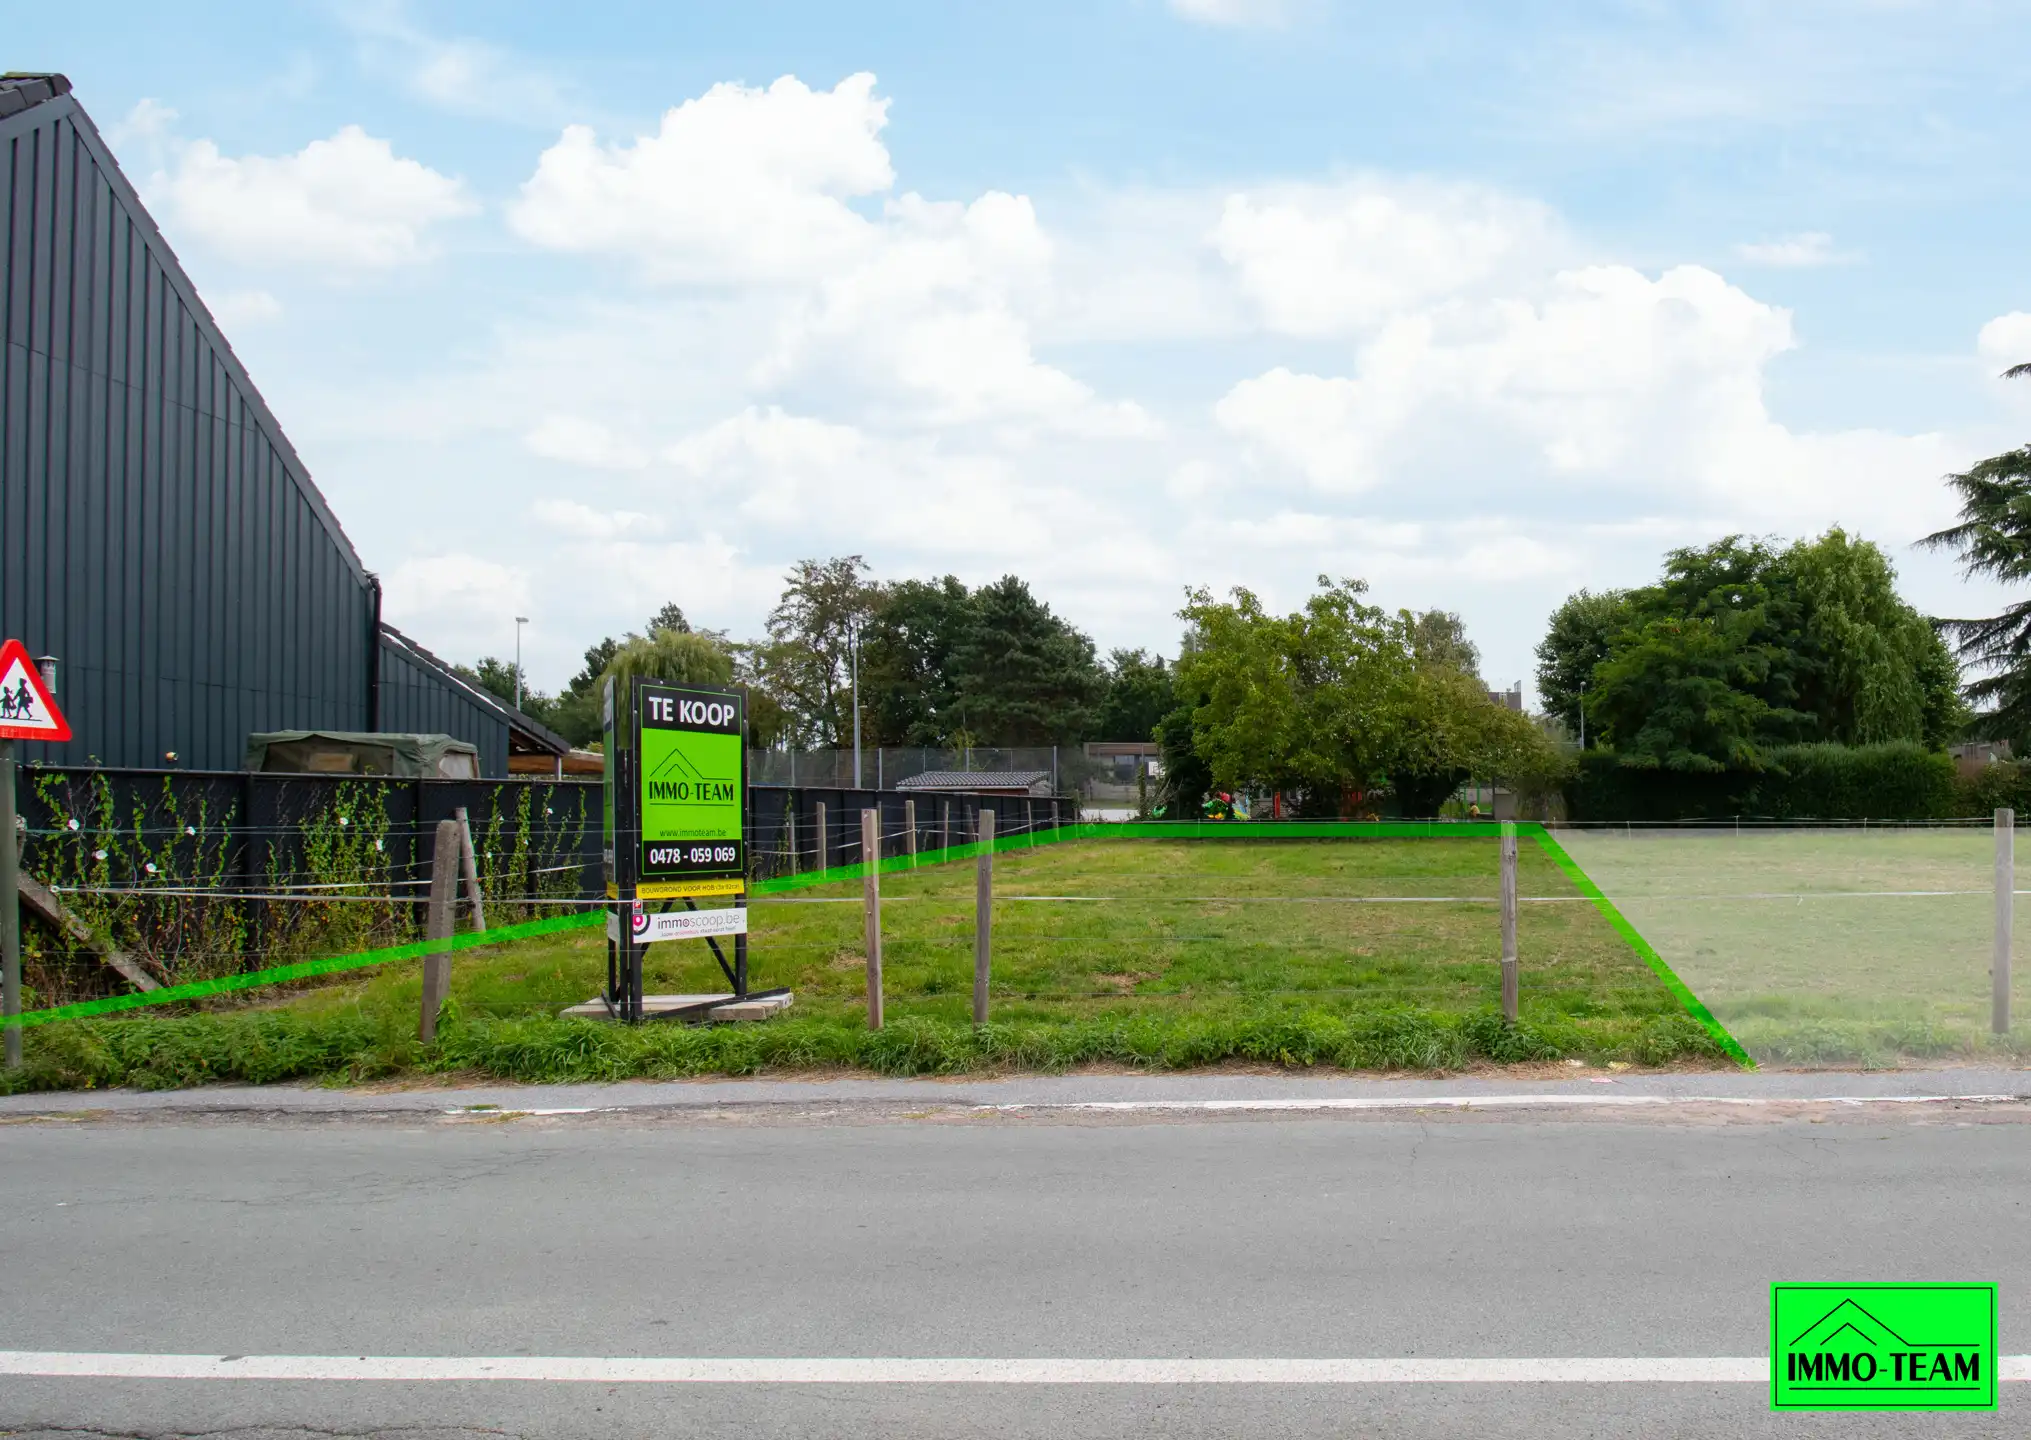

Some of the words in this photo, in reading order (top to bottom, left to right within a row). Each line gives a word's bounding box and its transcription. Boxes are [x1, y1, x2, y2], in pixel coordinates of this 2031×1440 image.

[648, 696, 674, 722] TE
[680, 699, 735, 727] KOOP
[649, 780, 734, 801] IMMO-TEAM
[659, 827, 727, 837] www.immoteam.be
[649, 847, 681, 864] 0478
[690, 847, 712, 863] 059
[714, 846, 736, 862] 069
[657, 911, 740, 930] immoscoop.be
